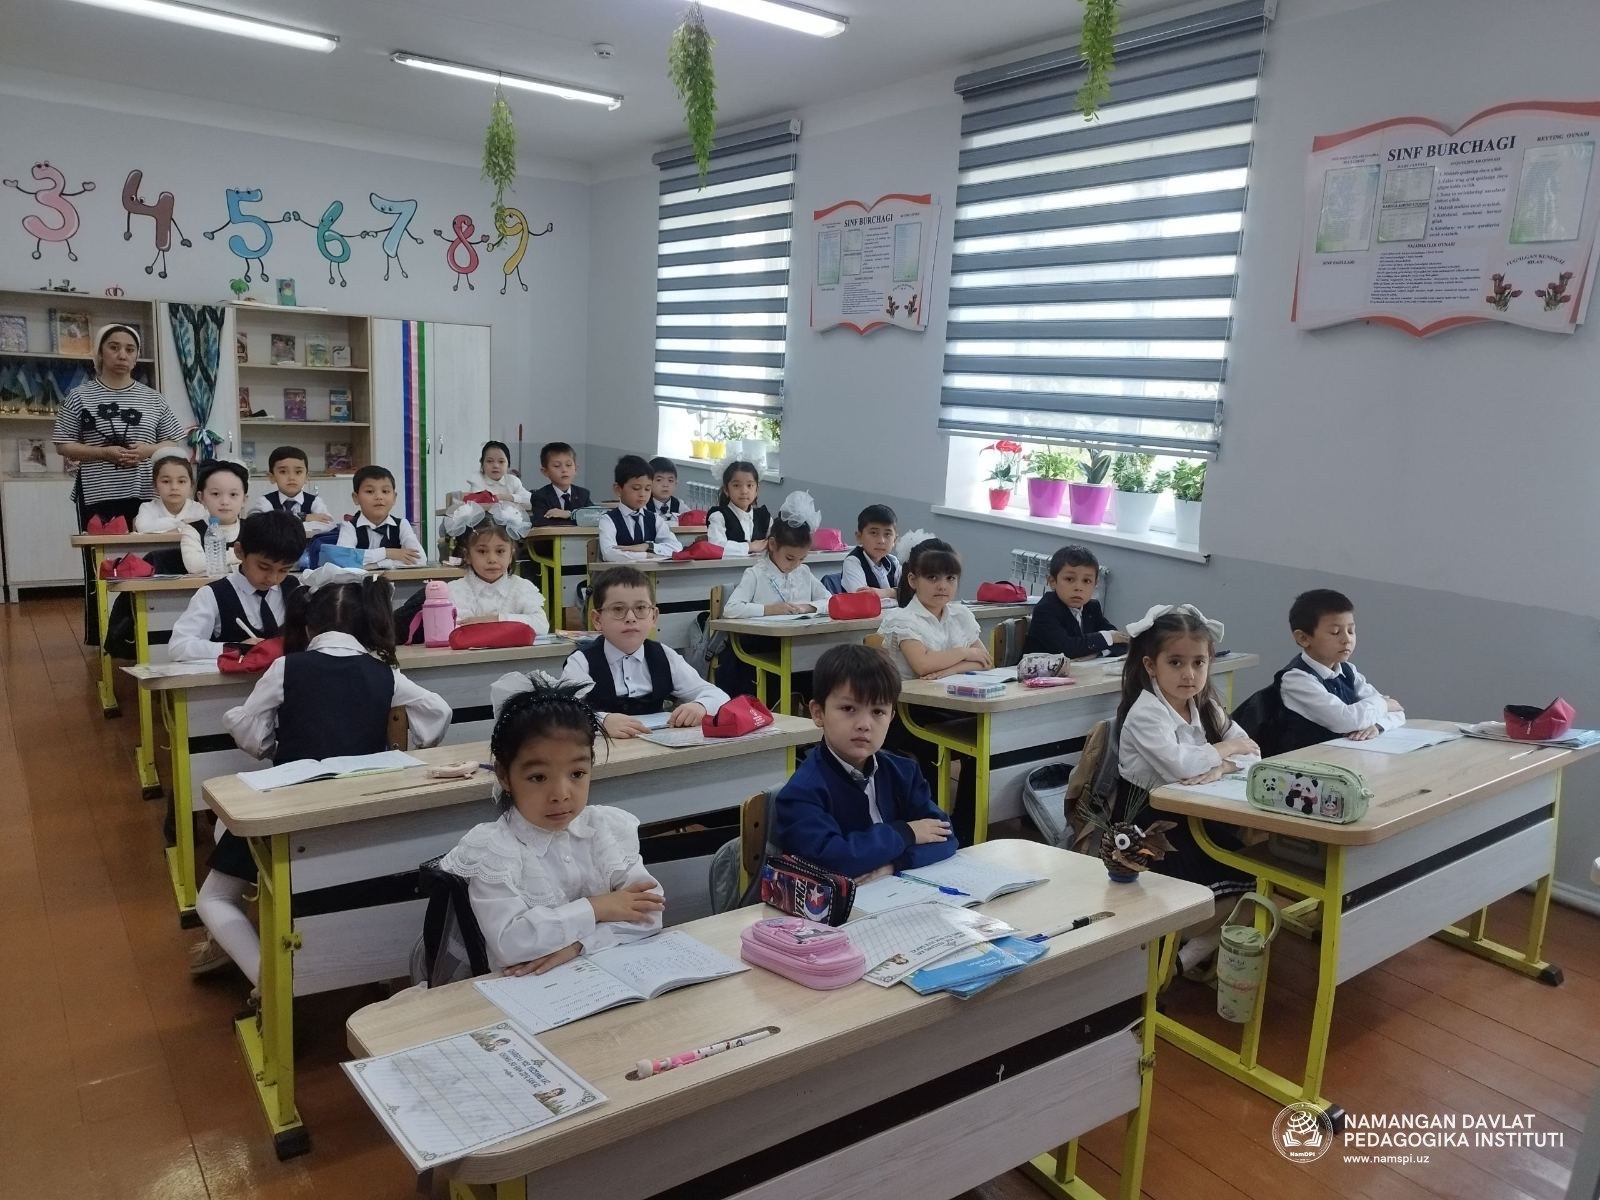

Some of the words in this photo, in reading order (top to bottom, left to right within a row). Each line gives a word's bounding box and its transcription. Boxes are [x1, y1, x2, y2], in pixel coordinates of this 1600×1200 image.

[1387, 147, 1424, 162] SINF
[1426, 135, 1517, 158] BURCHAGI
[22, 163, 80, 242] 3
[121, 169, 175, 252] 4
[225, 188, 273, 259] 5
[316, 200, 351, 263] 6
[369, 192, 418, 258] 7
[843, 218, 859, 227] SINF
[859, 213, 894, 226] BURCHAGI
[447, 214, 479, 274] 8
[494, 207, 529, 276] 9
